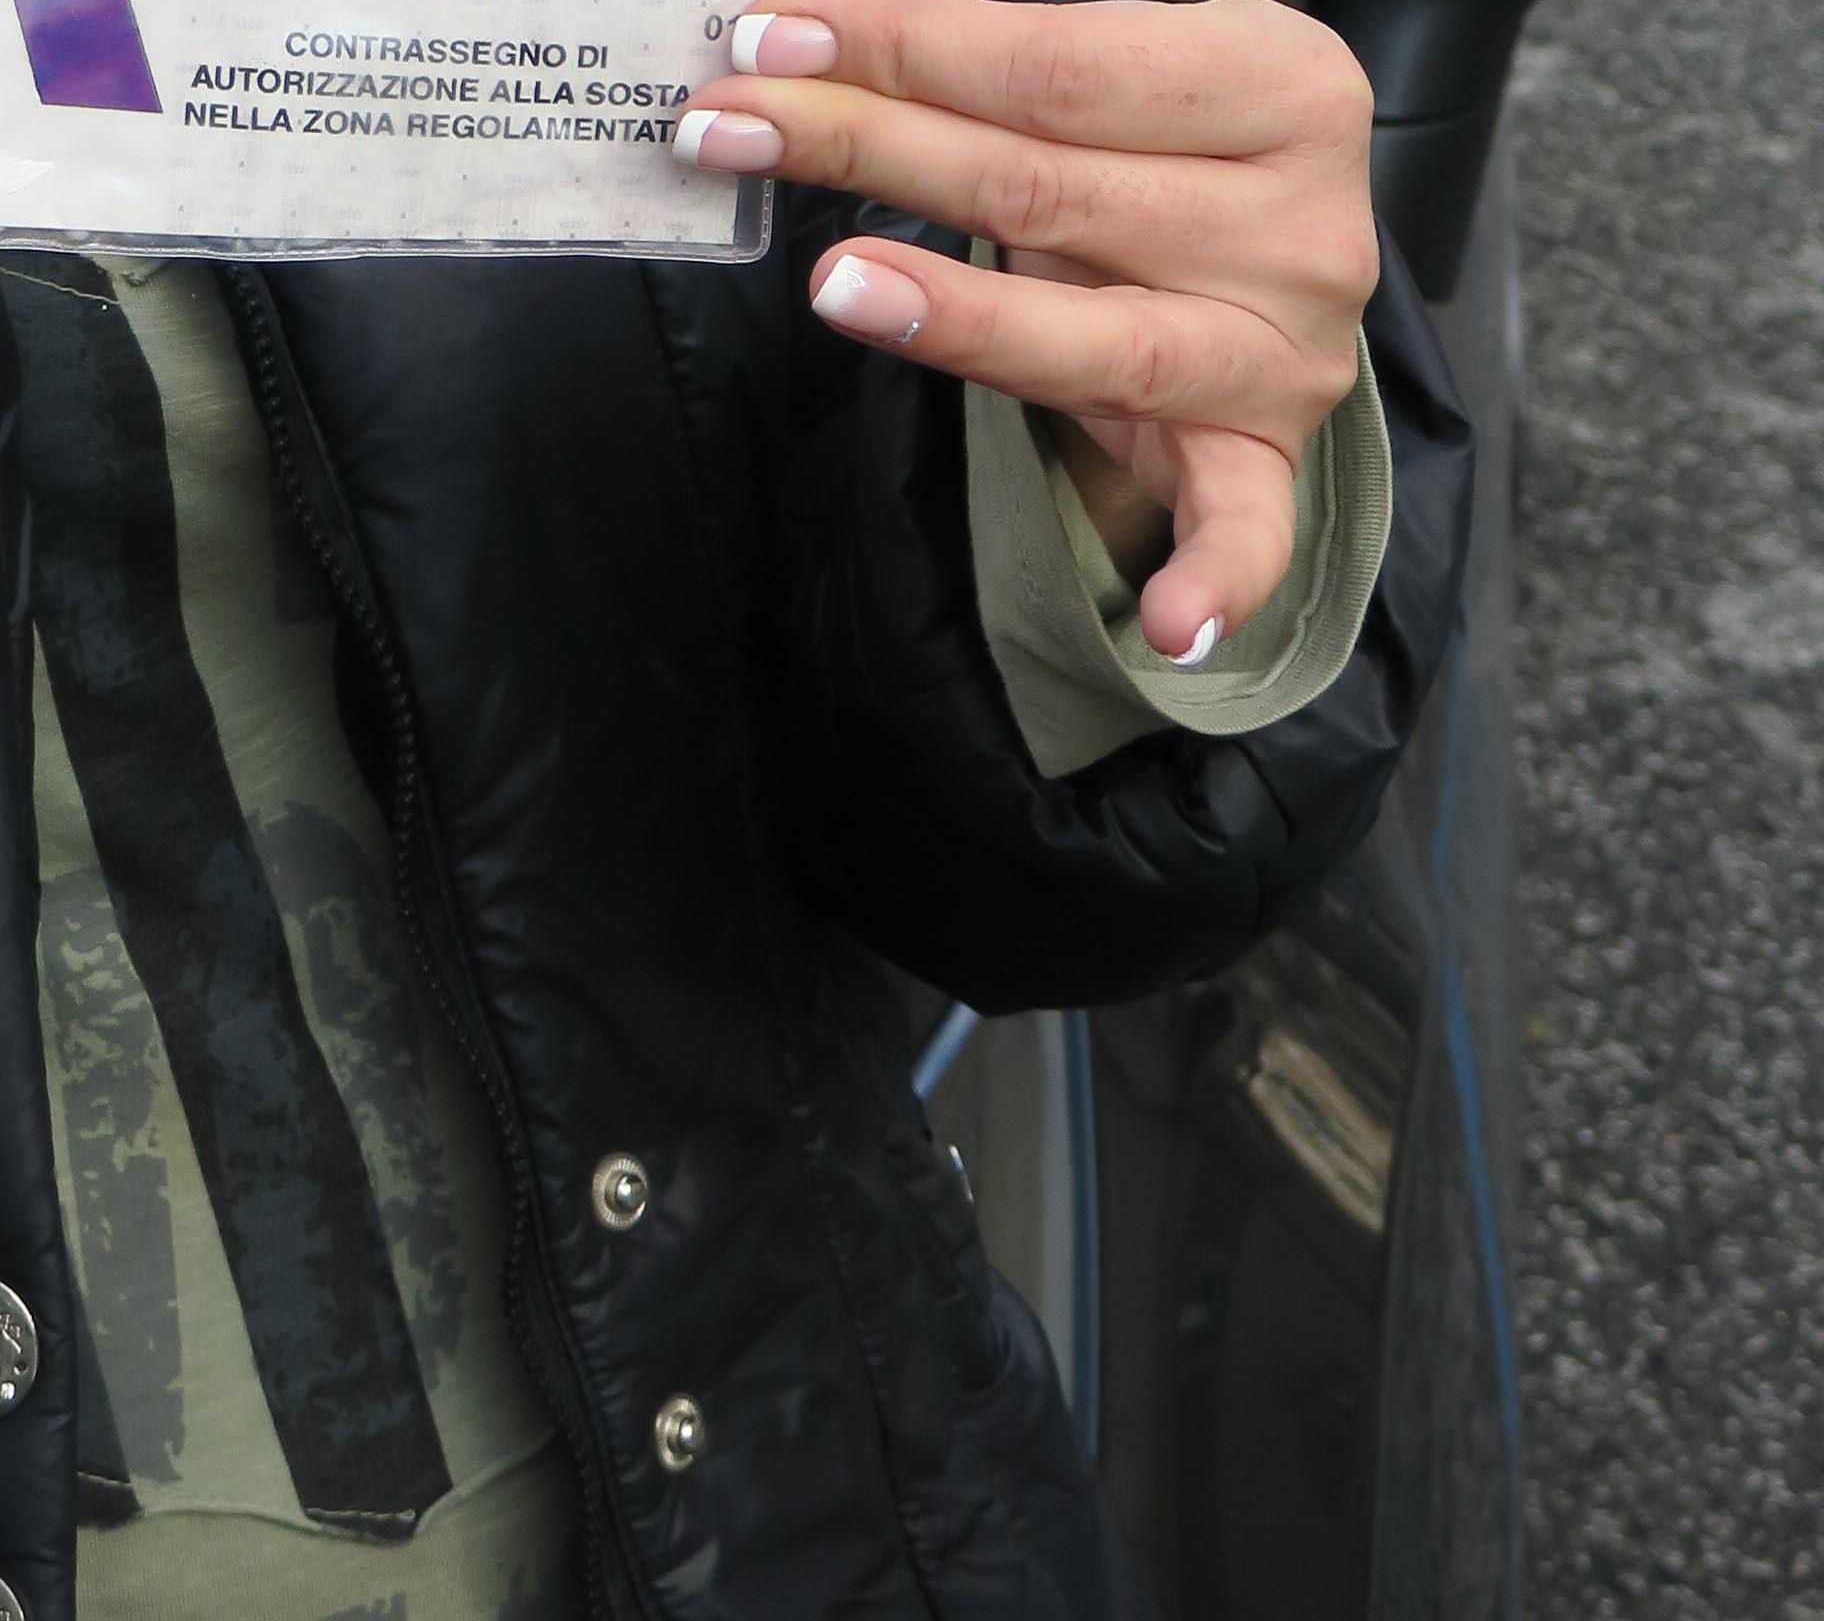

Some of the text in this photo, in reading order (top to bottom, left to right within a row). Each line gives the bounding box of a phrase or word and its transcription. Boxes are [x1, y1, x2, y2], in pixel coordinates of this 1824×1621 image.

[285, 31, 608, 69] CONTRASSEGNO DI
[191, 64, 690, 108] AUTORIZZAZIONE ALLA SOSTA
[184, 101, 676, 143] NELLA ZONA REGOLAMENTAT
